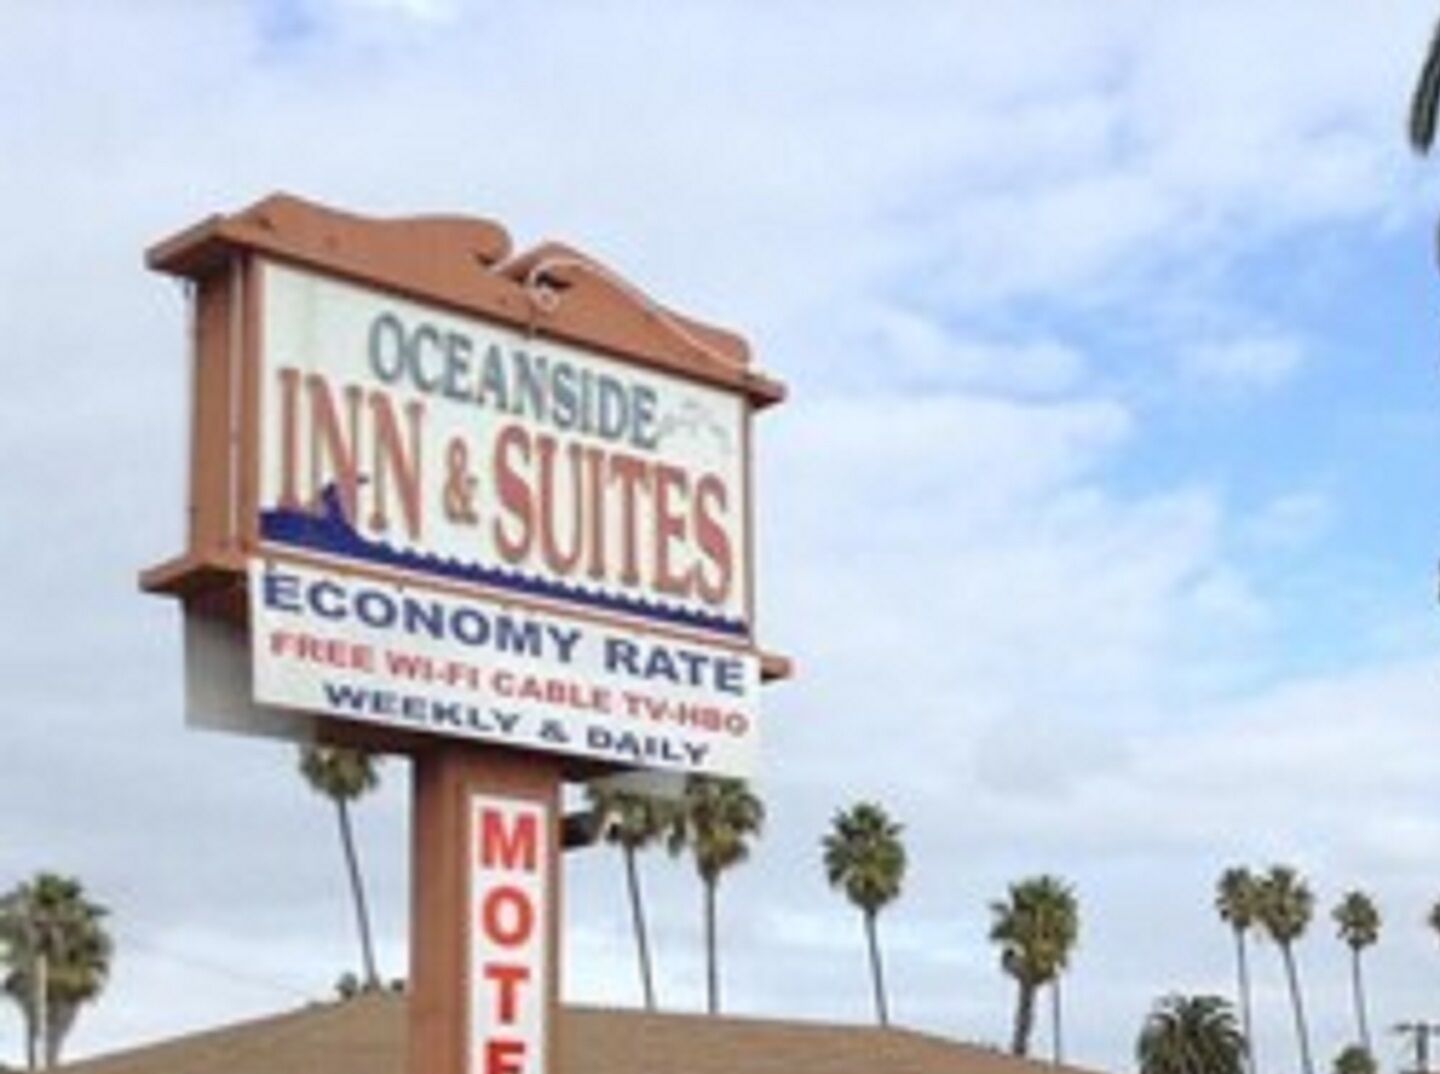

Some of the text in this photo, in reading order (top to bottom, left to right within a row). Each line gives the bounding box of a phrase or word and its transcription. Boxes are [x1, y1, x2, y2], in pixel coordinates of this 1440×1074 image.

[368, 313, 660, 450] OCEANSIDE
[277, 367, 732, 606] INN & SUITES
[263, 571, 746, 693] ECONOMY RATE
[270, 630, 749, 737] FREE WI-FI CABLE TV-HBO
[324, 682, 711, 767] WEEKLY & DAILY
